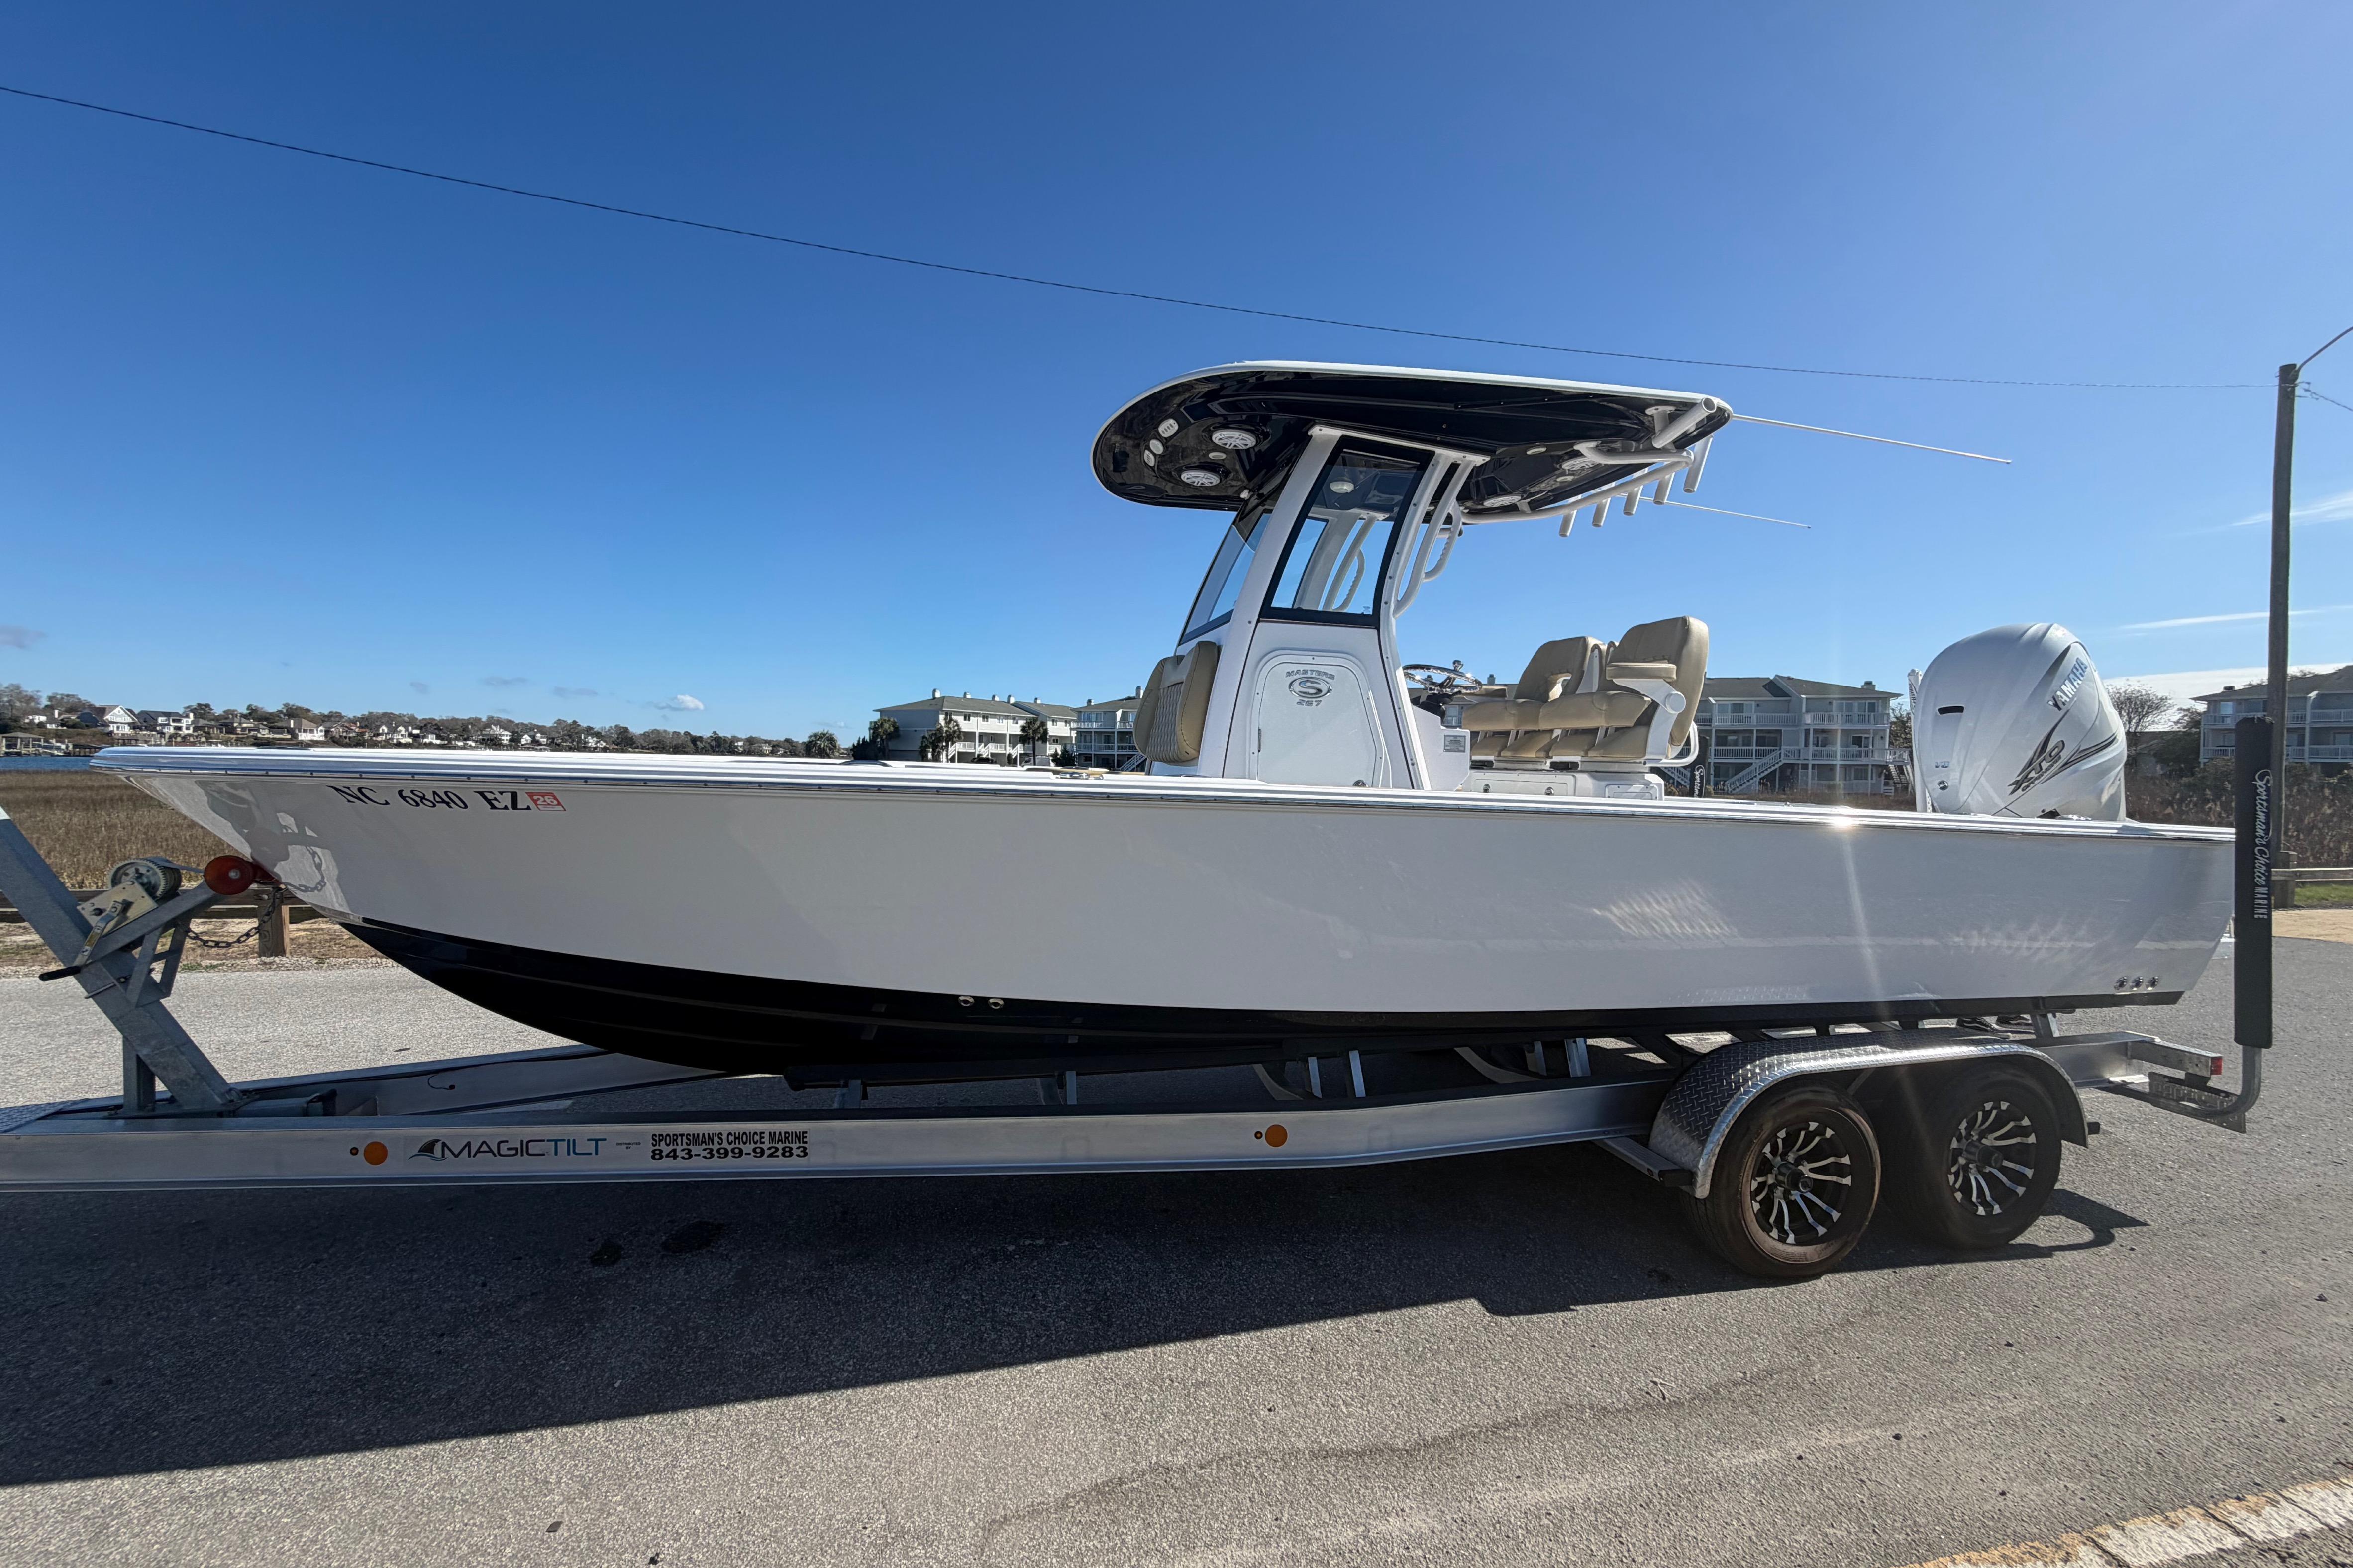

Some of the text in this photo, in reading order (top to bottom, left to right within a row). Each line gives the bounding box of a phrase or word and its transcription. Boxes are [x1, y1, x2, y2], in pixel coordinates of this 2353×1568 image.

[1286, 669, 1335, 680] MASTERS
[2047, 657, 2088, 711] YAMAHA
[2007, 740, 2065, 796] XTO
[326, 785, 532, 811] NC 6840 EZ
[533, 795, 558, 805] 26
[2252, 769, 2273, 919] Sportsman's Choice MARINE
[441, 1138, 607, 1158] MAGICTILT
[651, 1131, 808, 1147] SPORTSMAN'S CHOICE MARINE
[650, 1146, 809, 1161] 843-399-9283
